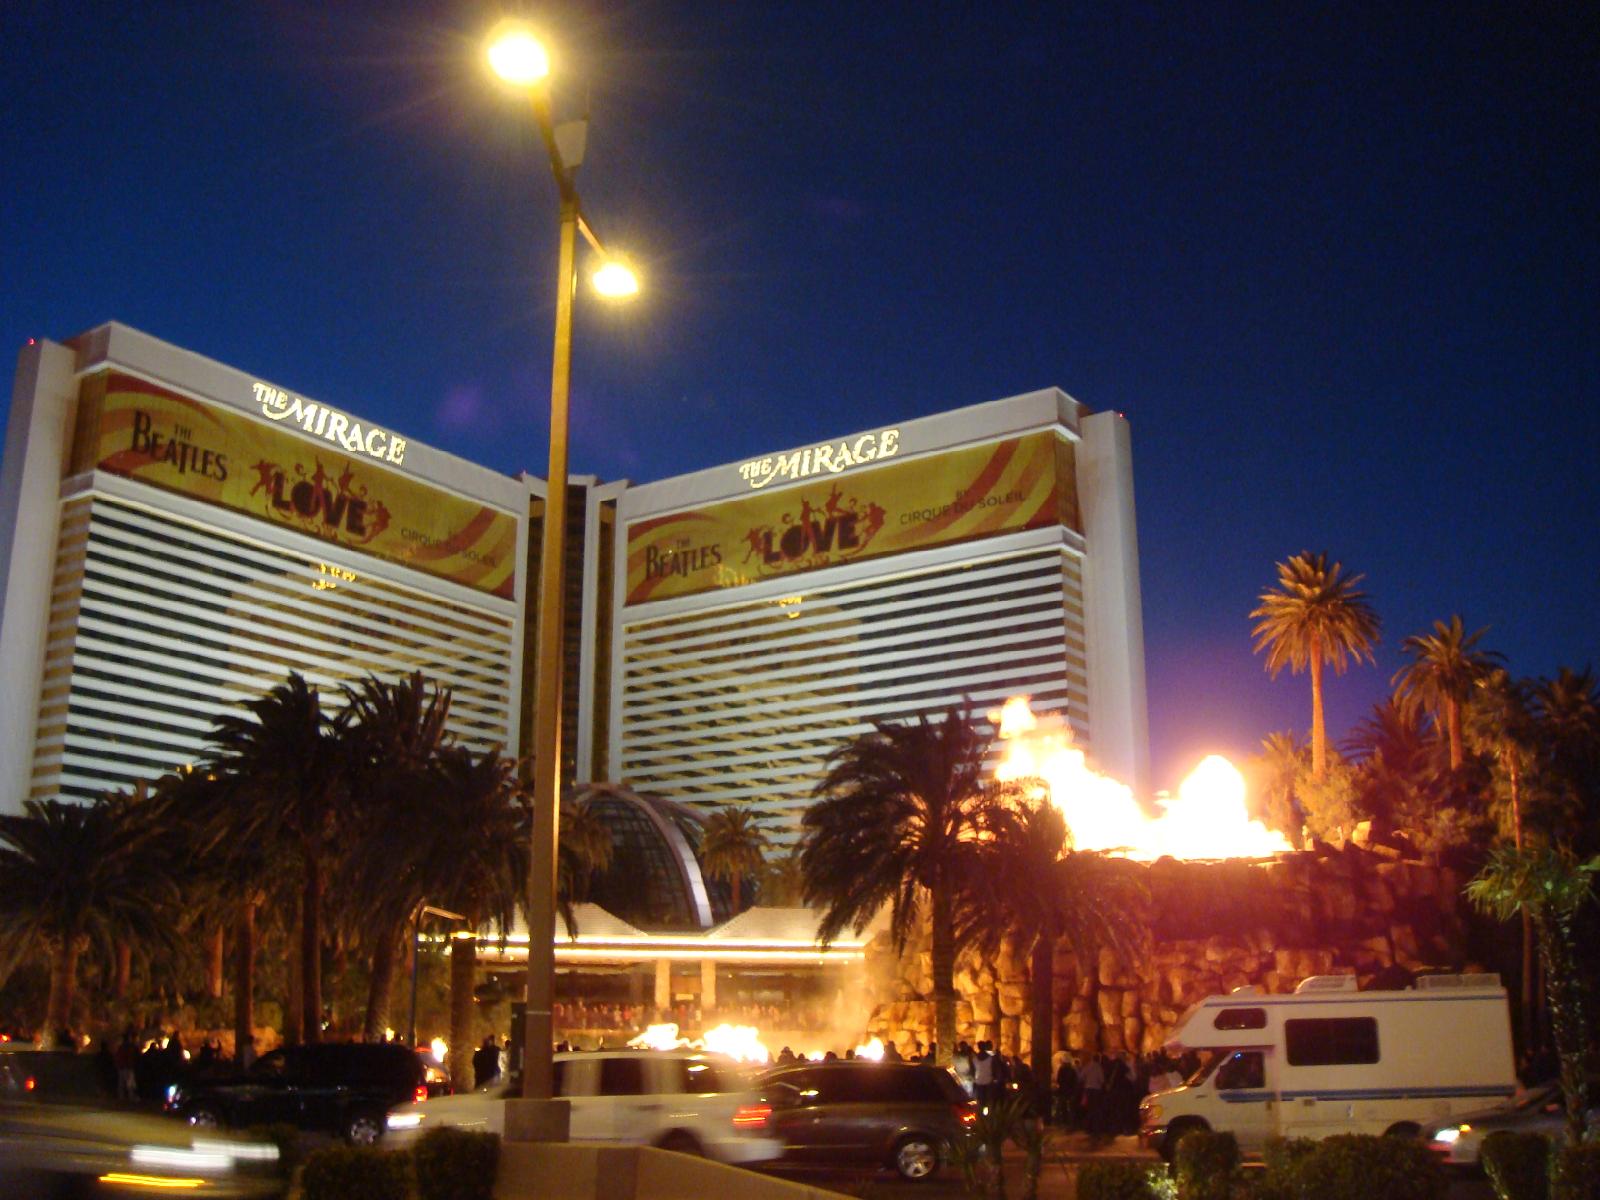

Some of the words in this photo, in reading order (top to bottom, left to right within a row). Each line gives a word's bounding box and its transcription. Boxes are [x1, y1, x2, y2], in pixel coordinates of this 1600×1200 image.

[253, 382, 288, 409] THE
[132, 410, 227, 481] BEATLES
[262, 399, 406, 466] MIRAGE
[739, 458, 772, 479] THE
[751, 430, 899, 488] MIRAGE
[272, 471, 367, 536] LOVE
[900, 504, 951, 525] CIRQUE
[977, 490, 1027, 510] SOLEIL
[645, 543, 722, 580] BEATLES
[763, 512, 860, 564] LOVE
